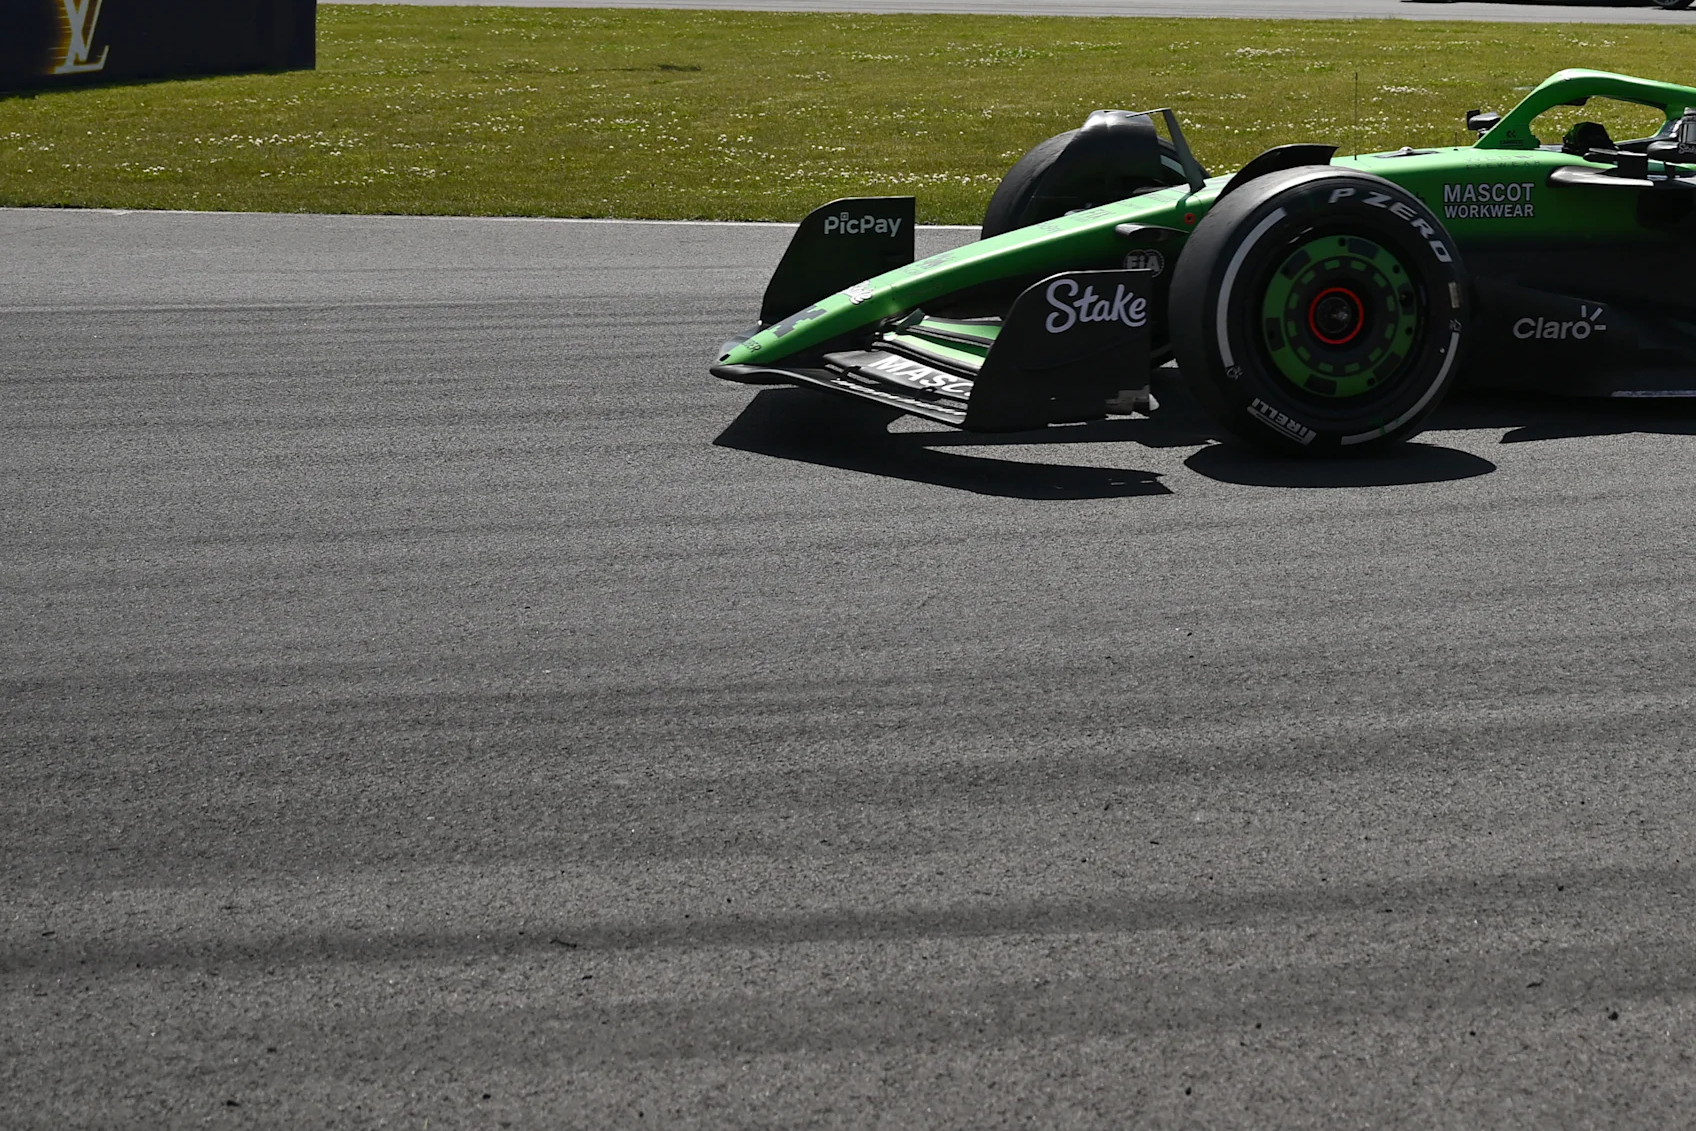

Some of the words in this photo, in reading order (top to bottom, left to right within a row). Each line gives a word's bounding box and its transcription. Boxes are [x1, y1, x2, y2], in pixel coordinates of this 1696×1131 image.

[1444, 183, 1535, 203] MASCOT
[823, 212, 902, 239] PicPay
[1328, 187, 1356, 204] P
[1361, 191, 1453, 263] ZERO
[1444, 204, 1534, 218] WORKWEAR
[1046, 279, 1147, 333] Stake
[1512, 317, 1592, 340] Claro
[867, 354, 974, 397] MASC
[1246, 398, 1318, 446] PIRELLI
